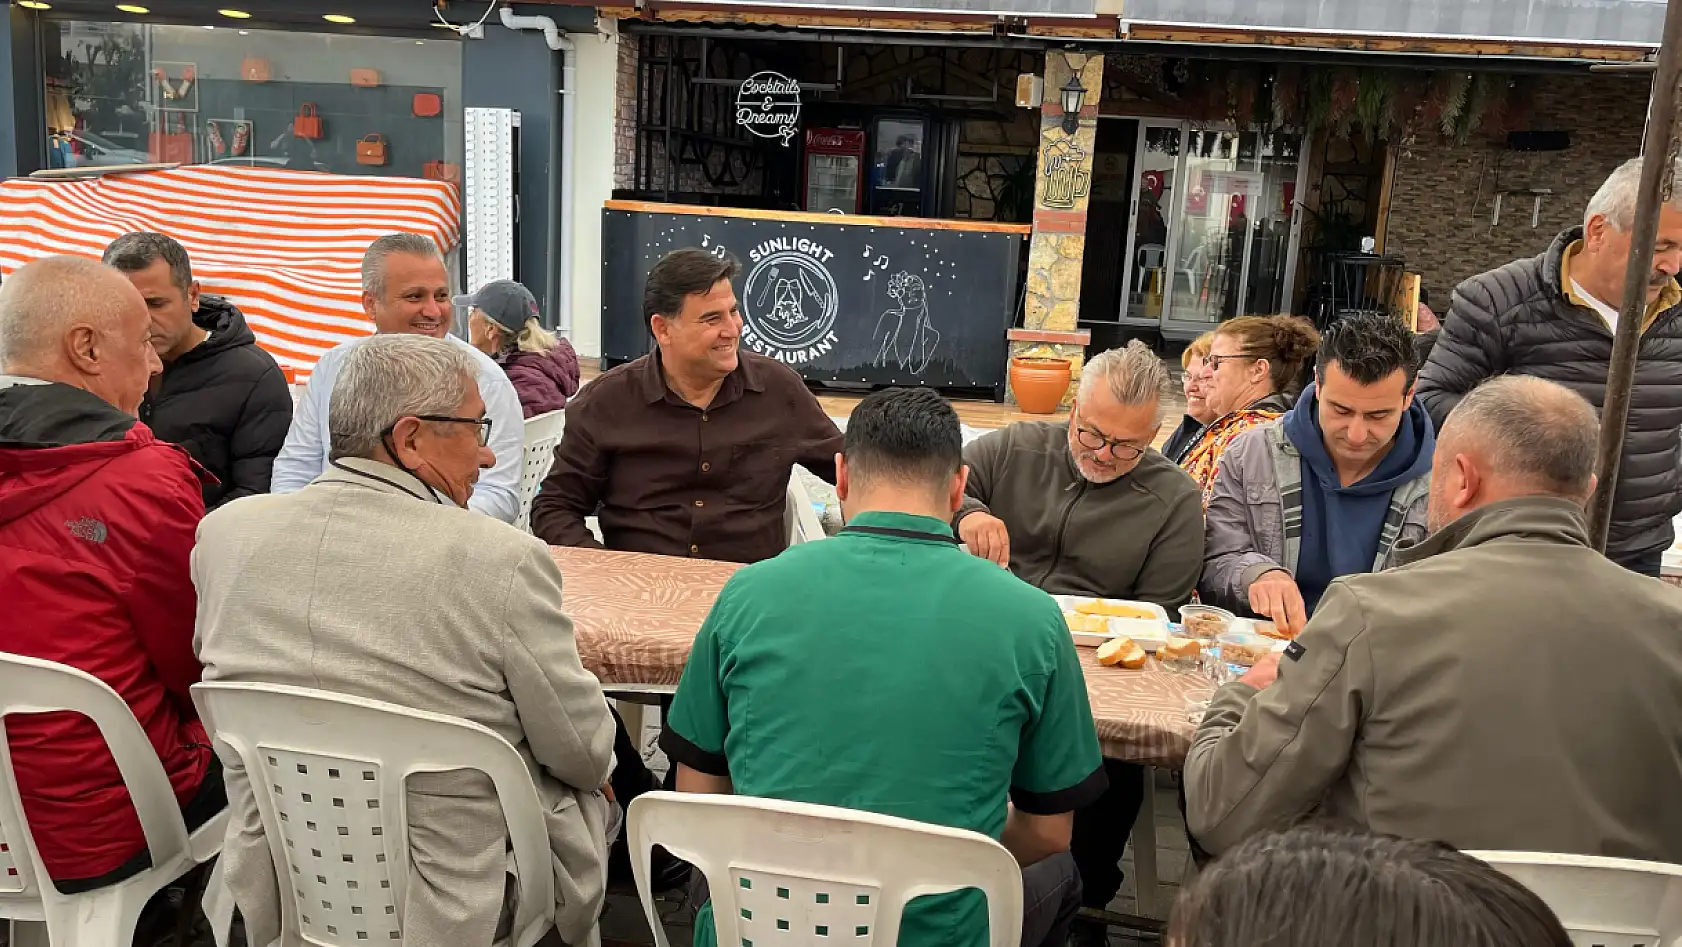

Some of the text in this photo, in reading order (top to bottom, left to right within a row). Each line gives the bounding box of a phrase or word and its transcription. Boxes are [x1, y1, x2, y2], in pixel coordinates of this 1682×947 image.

[741, 77, 800, 94] Cocktails
[761, 96, 774, 111] &
[736, 108, 797, 125] Dreams
[749, 236, 834, 263] SUNLIGHT
